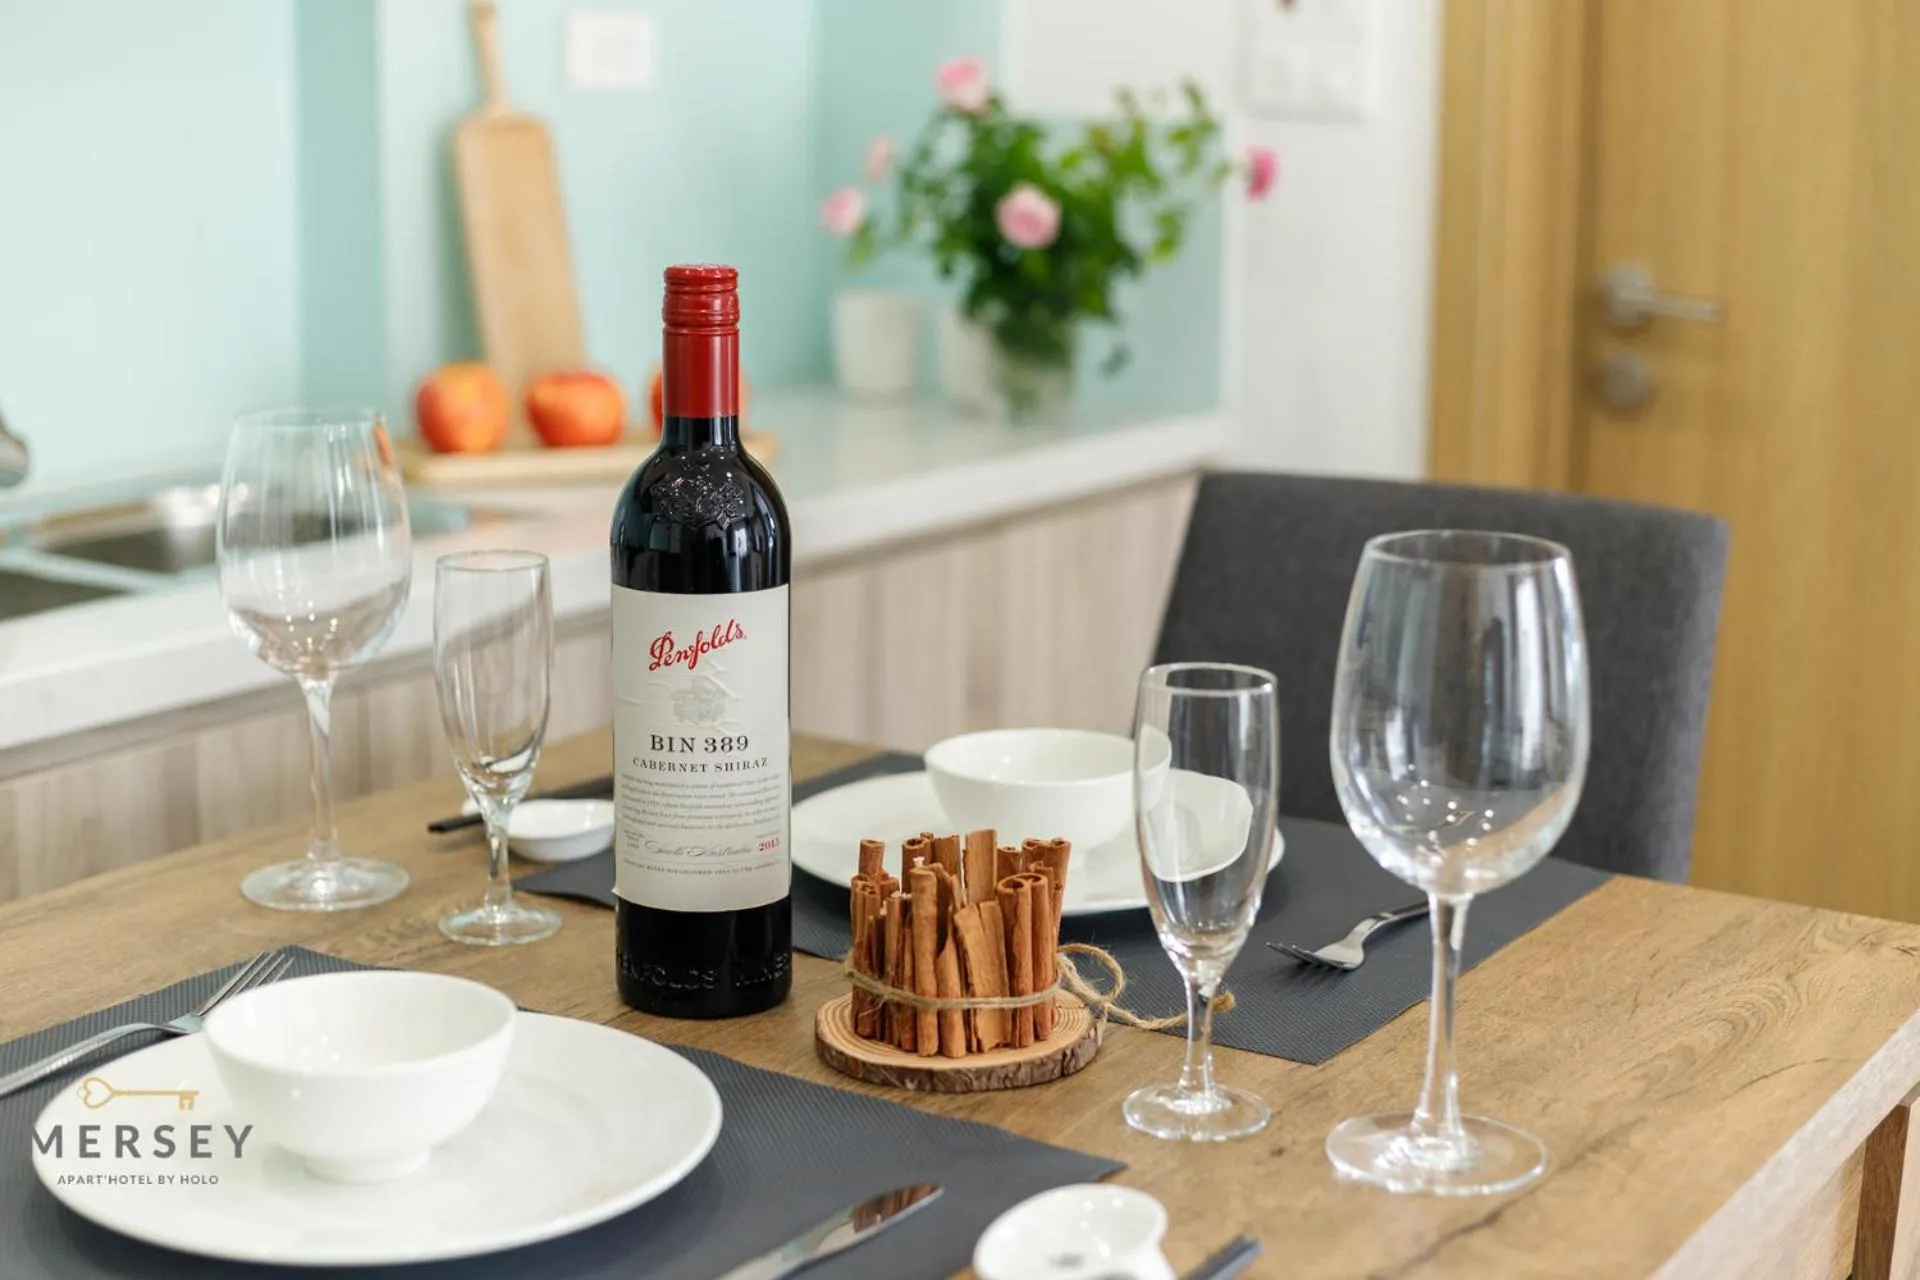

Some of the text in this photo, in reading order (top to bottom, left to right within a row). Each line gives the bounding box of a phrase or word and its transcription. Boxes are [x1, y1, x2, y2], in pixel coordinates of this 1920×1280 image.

[650, 734, 749, 753] BIN 389
[632, 757, 769, 773] CABERNET SHIRAZ
